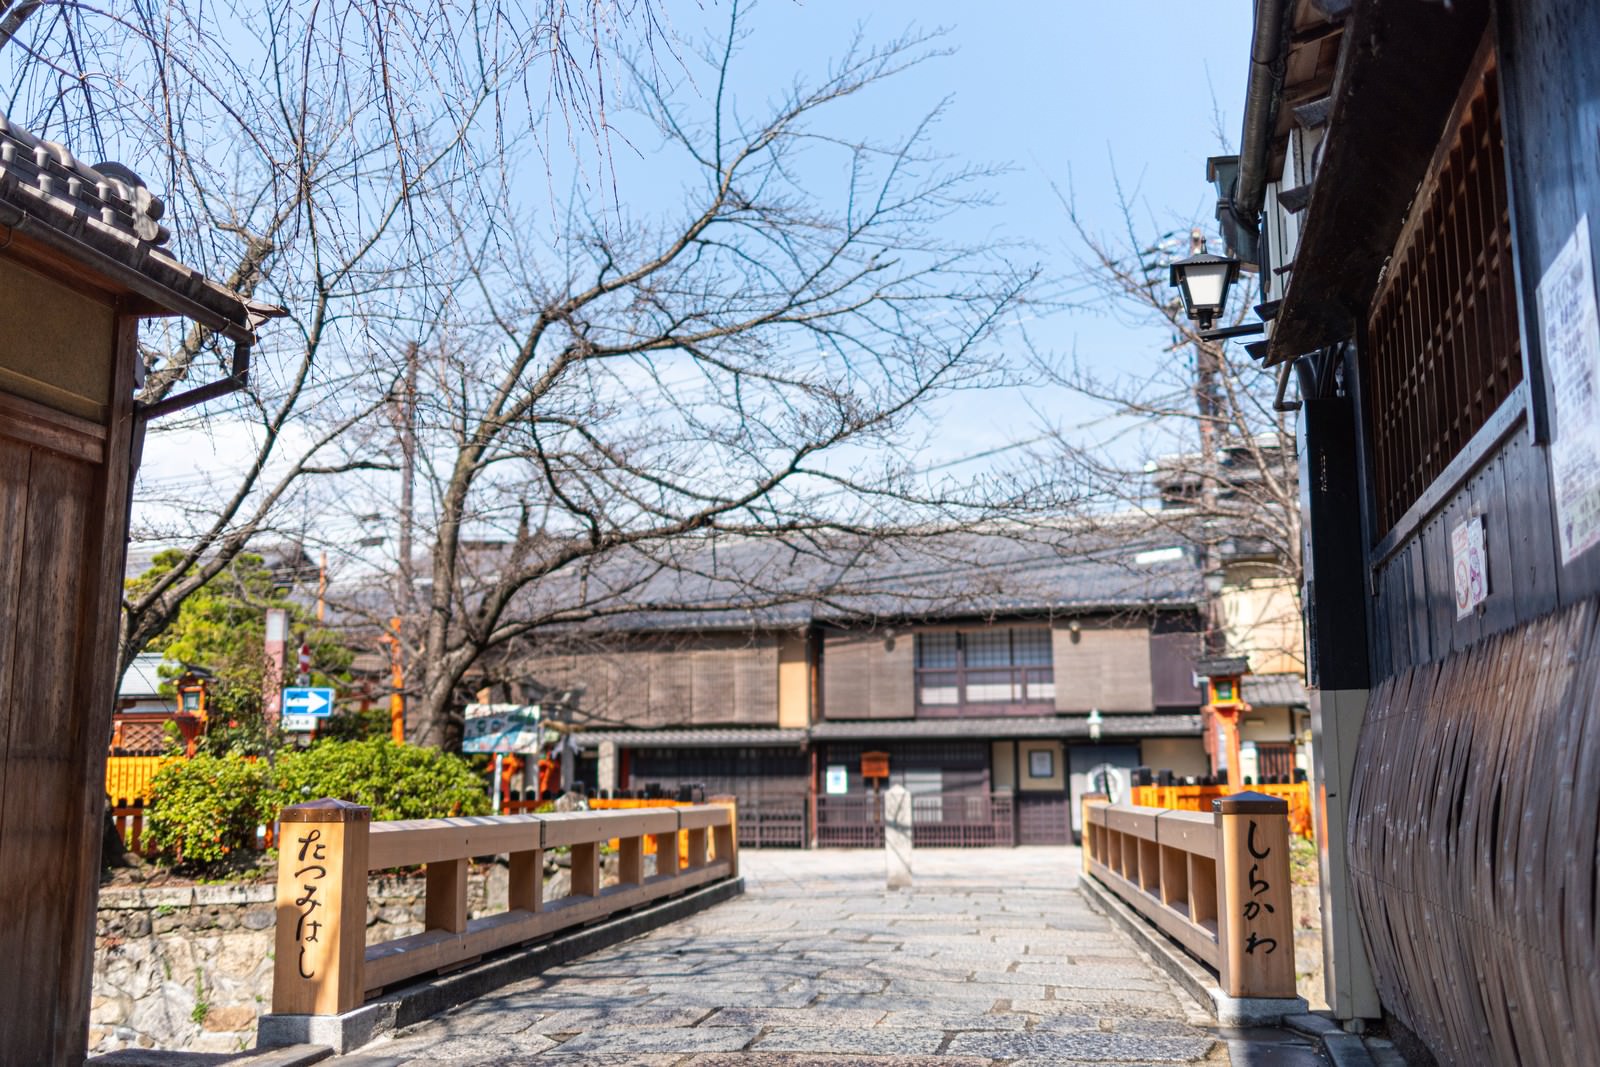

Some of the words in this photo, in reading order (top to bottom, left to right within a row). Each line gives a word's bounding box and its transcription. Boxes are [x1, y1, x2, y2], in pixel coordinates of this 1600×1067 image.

[294, 829, 326, 979] たつみはし
[1242, 819, 1277, 955] しらかわ
